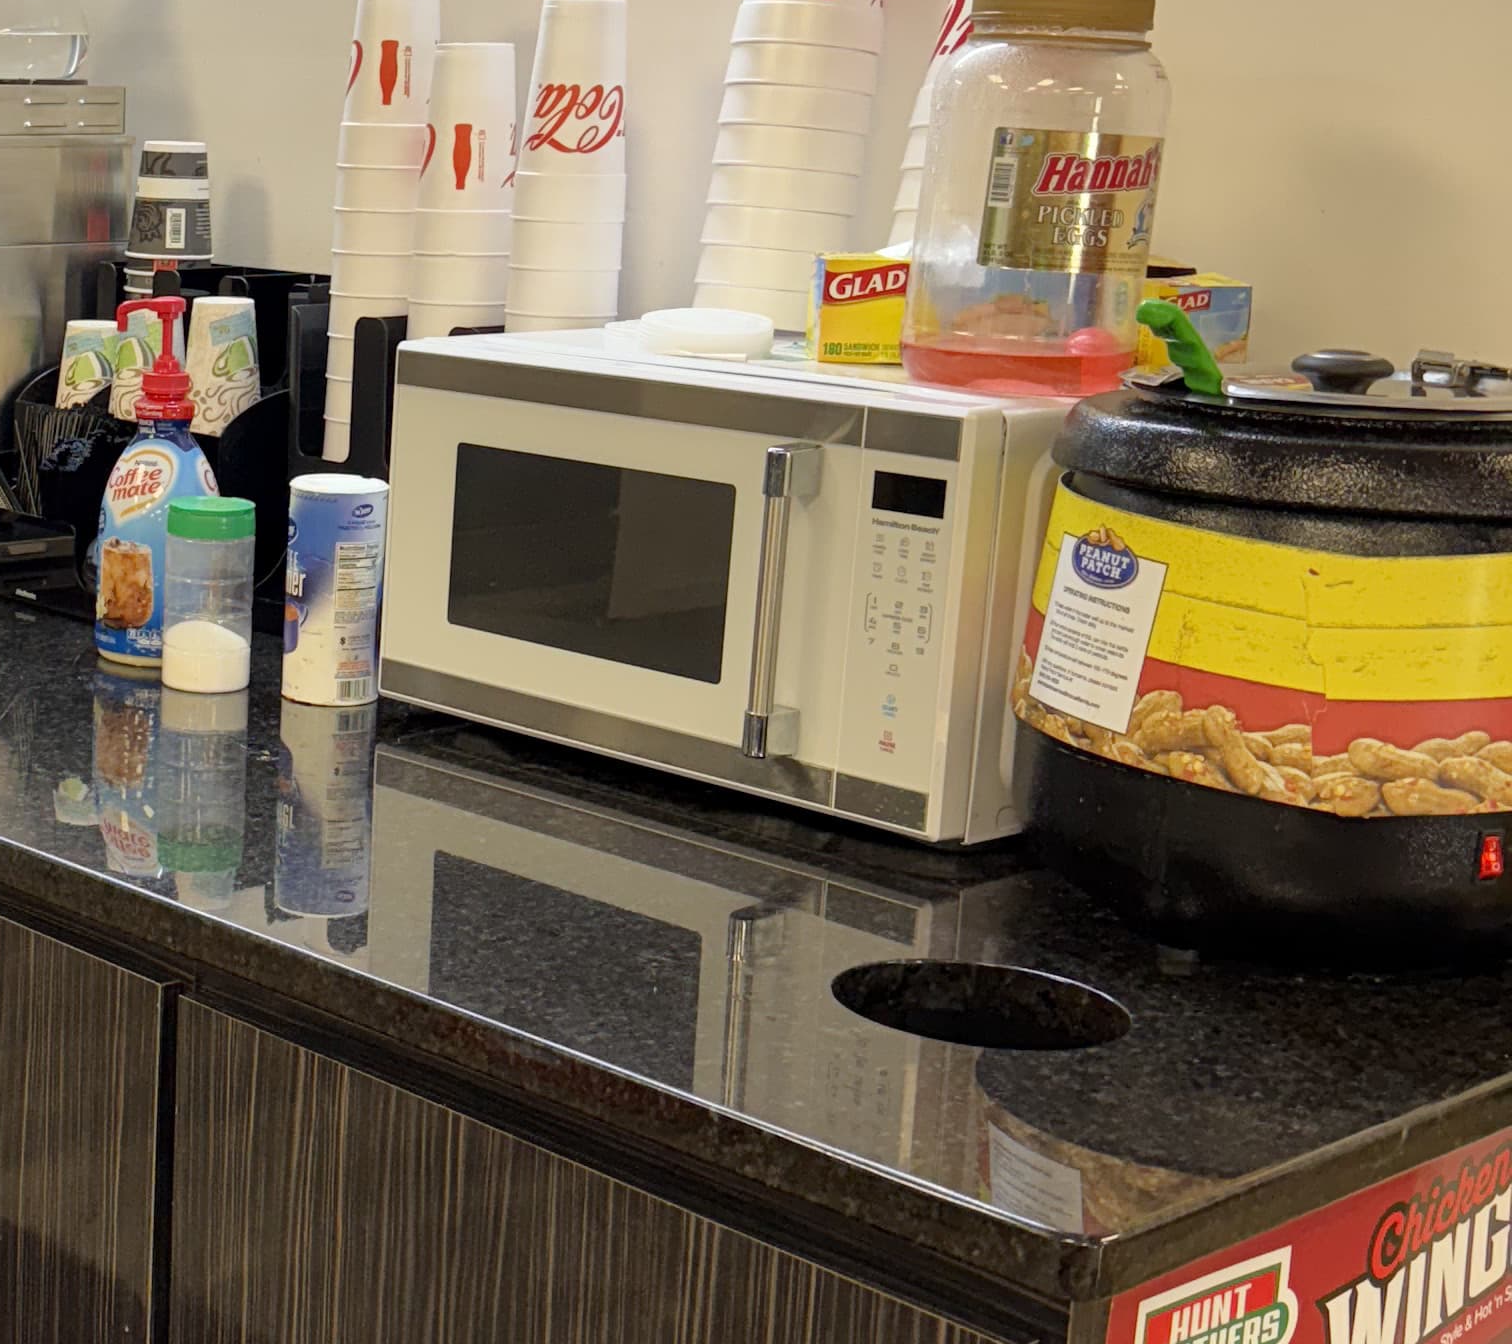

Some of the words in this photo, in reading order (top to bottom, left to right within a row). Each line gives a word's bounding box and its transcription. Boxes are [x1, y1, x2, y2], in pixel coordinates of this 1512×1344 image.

[1037, 205, 1125, 228] PICKLED
[1052, 226, 1109, 248] EGGS
[828, 269, 906, 300] GLAD
[111, 481, 162, 502] mate
[1079, 543, 1131, 569] PEANUT
[1081, 556, 1123, 580] PATCH
[1370, 1146, 1512, 1280] Chicken
[1169, 1283, 1253, 1344] HUNT
[1464, 1314, 1472, 1330] &
[1474, 1305, 1493, 1326] Hot
